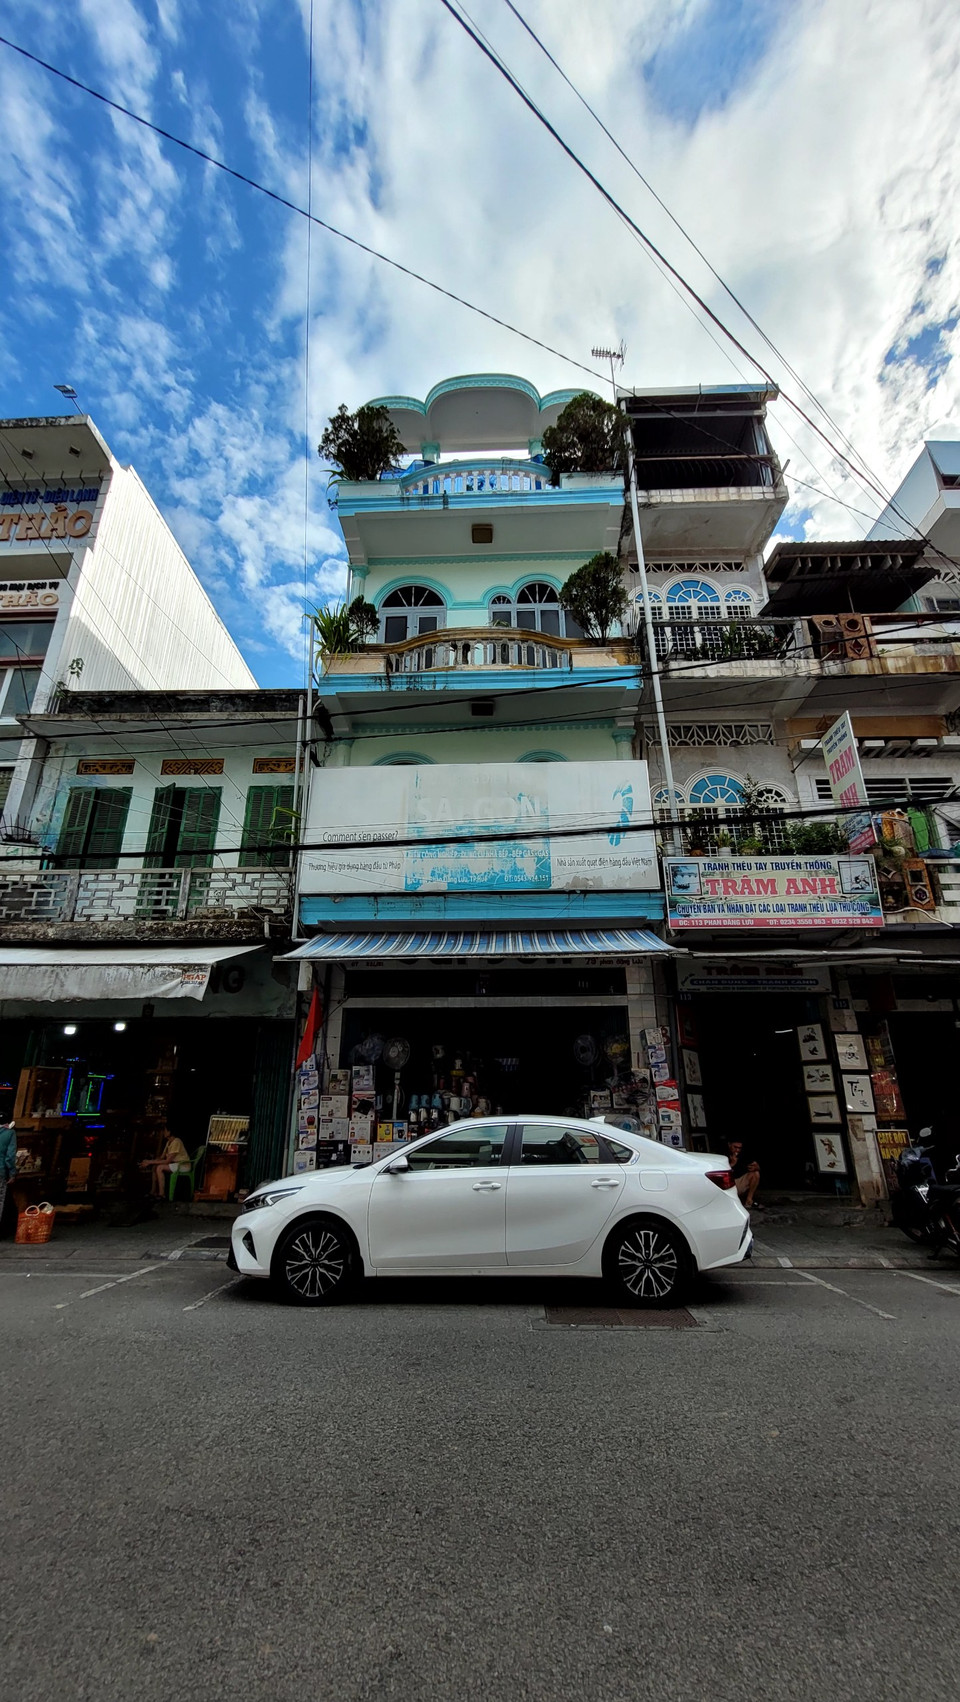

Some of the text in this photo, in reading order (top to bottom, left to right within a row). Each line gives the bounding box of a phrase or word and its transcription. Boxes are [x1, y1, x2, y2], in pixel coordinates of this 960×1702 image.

[323, 831, 357, 842] Comment
[373, 830, 398, 843] passer?
[702, 863, 729, 871] TRANH
[732, 861, 752, 871] THÊU
[754, 862, 768, 871] TAY
[705, 875, 838, 896] TRÂM ANH
[788, 903, 808, 913] TRANH
